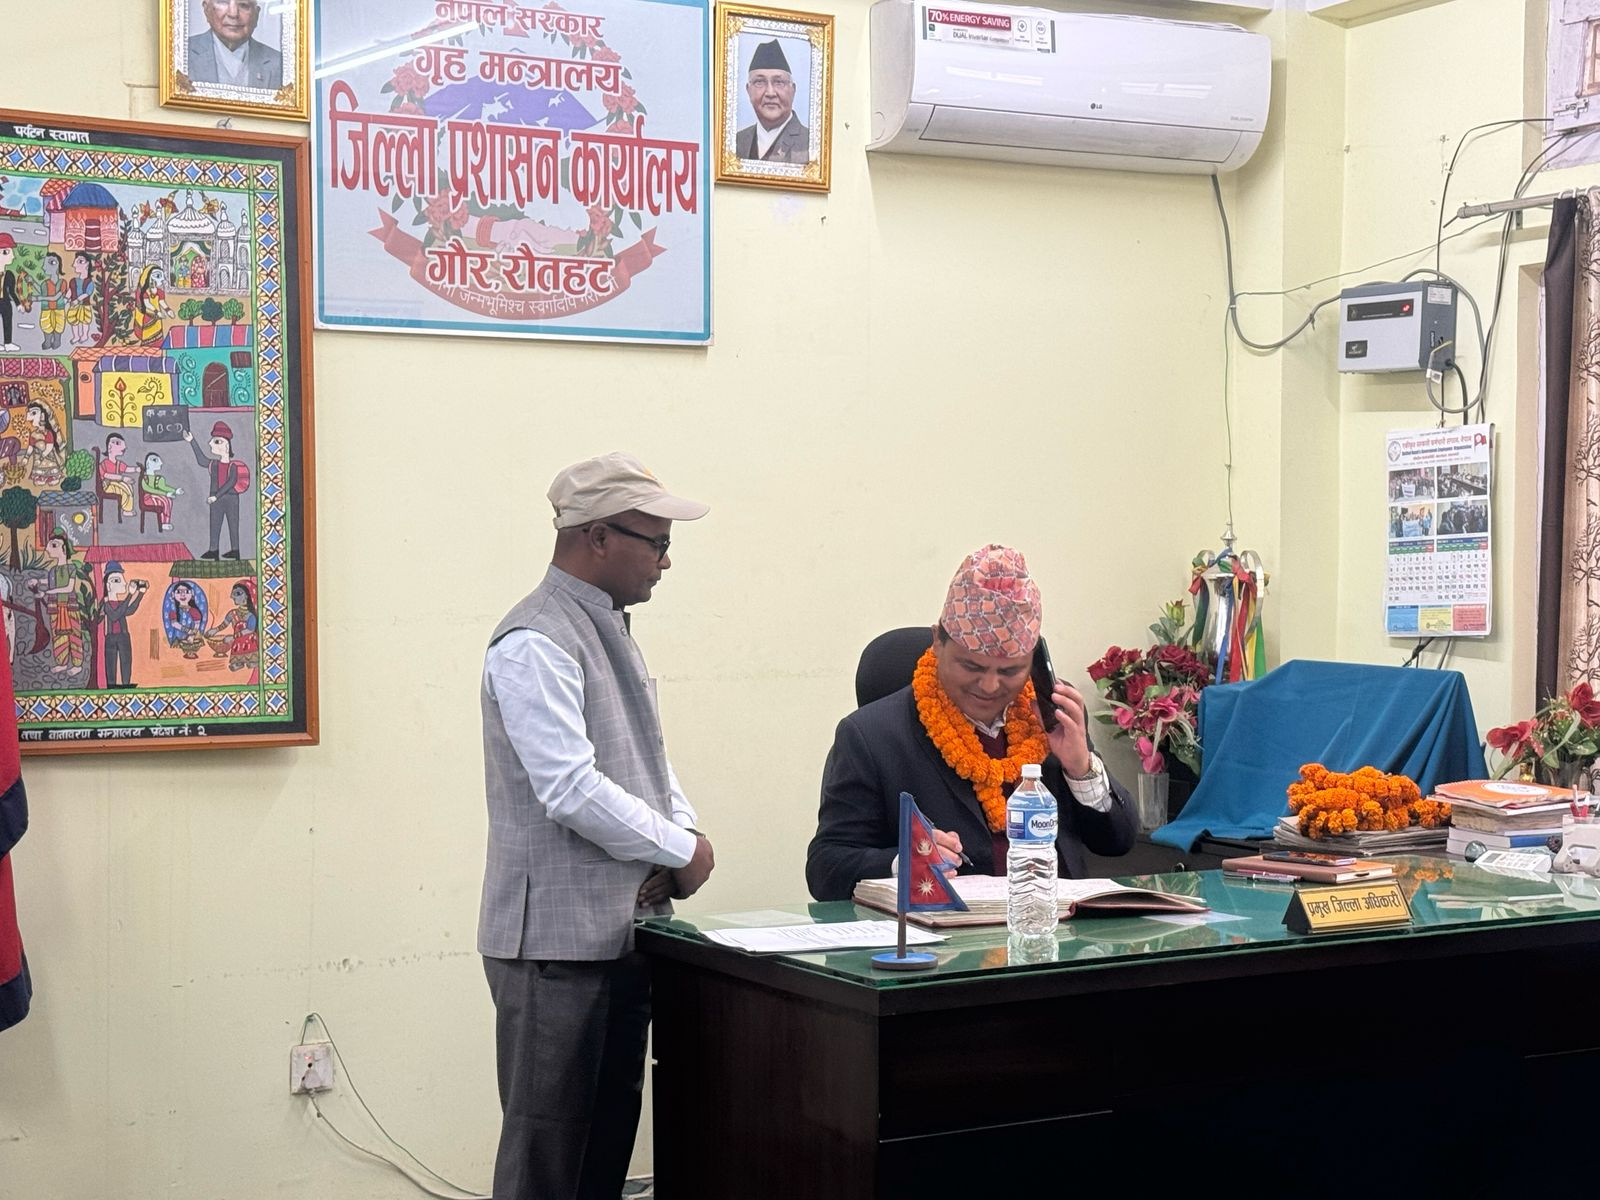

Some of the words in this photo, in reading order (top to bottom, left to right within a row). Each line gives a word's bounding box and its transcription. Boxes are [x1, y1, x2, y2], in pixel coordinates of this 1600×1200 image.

[516, 7, 605, 37] सरकार
[929, 10, 949, 21] 70%
[949, 13, 980, 24] ENERGY
[982, 16, 1010, 28] SAVING
[415, 46, 468, 86] गृह
[479, 51, 622, 94] मन्त्रालय
[49, 129, 90, 144] स्वागत
[329, 80, 438, 198] जिल्ला
[448, 121, 561, 210] प्रशासन
[571, 115, 700, 216] कार्यालय
[502, 243, 613, 295] रौतहट
[21, 729, 43, 741] तथा
[48, 728, 94, 740] वातावरण
[197, 725, 207, 736] २
[1307, 901, 1332, 918] प्रमुख
[1330, 895, 1362, 913] जिल्ला
[1361, 891, 1402, 910] अधिकारी
